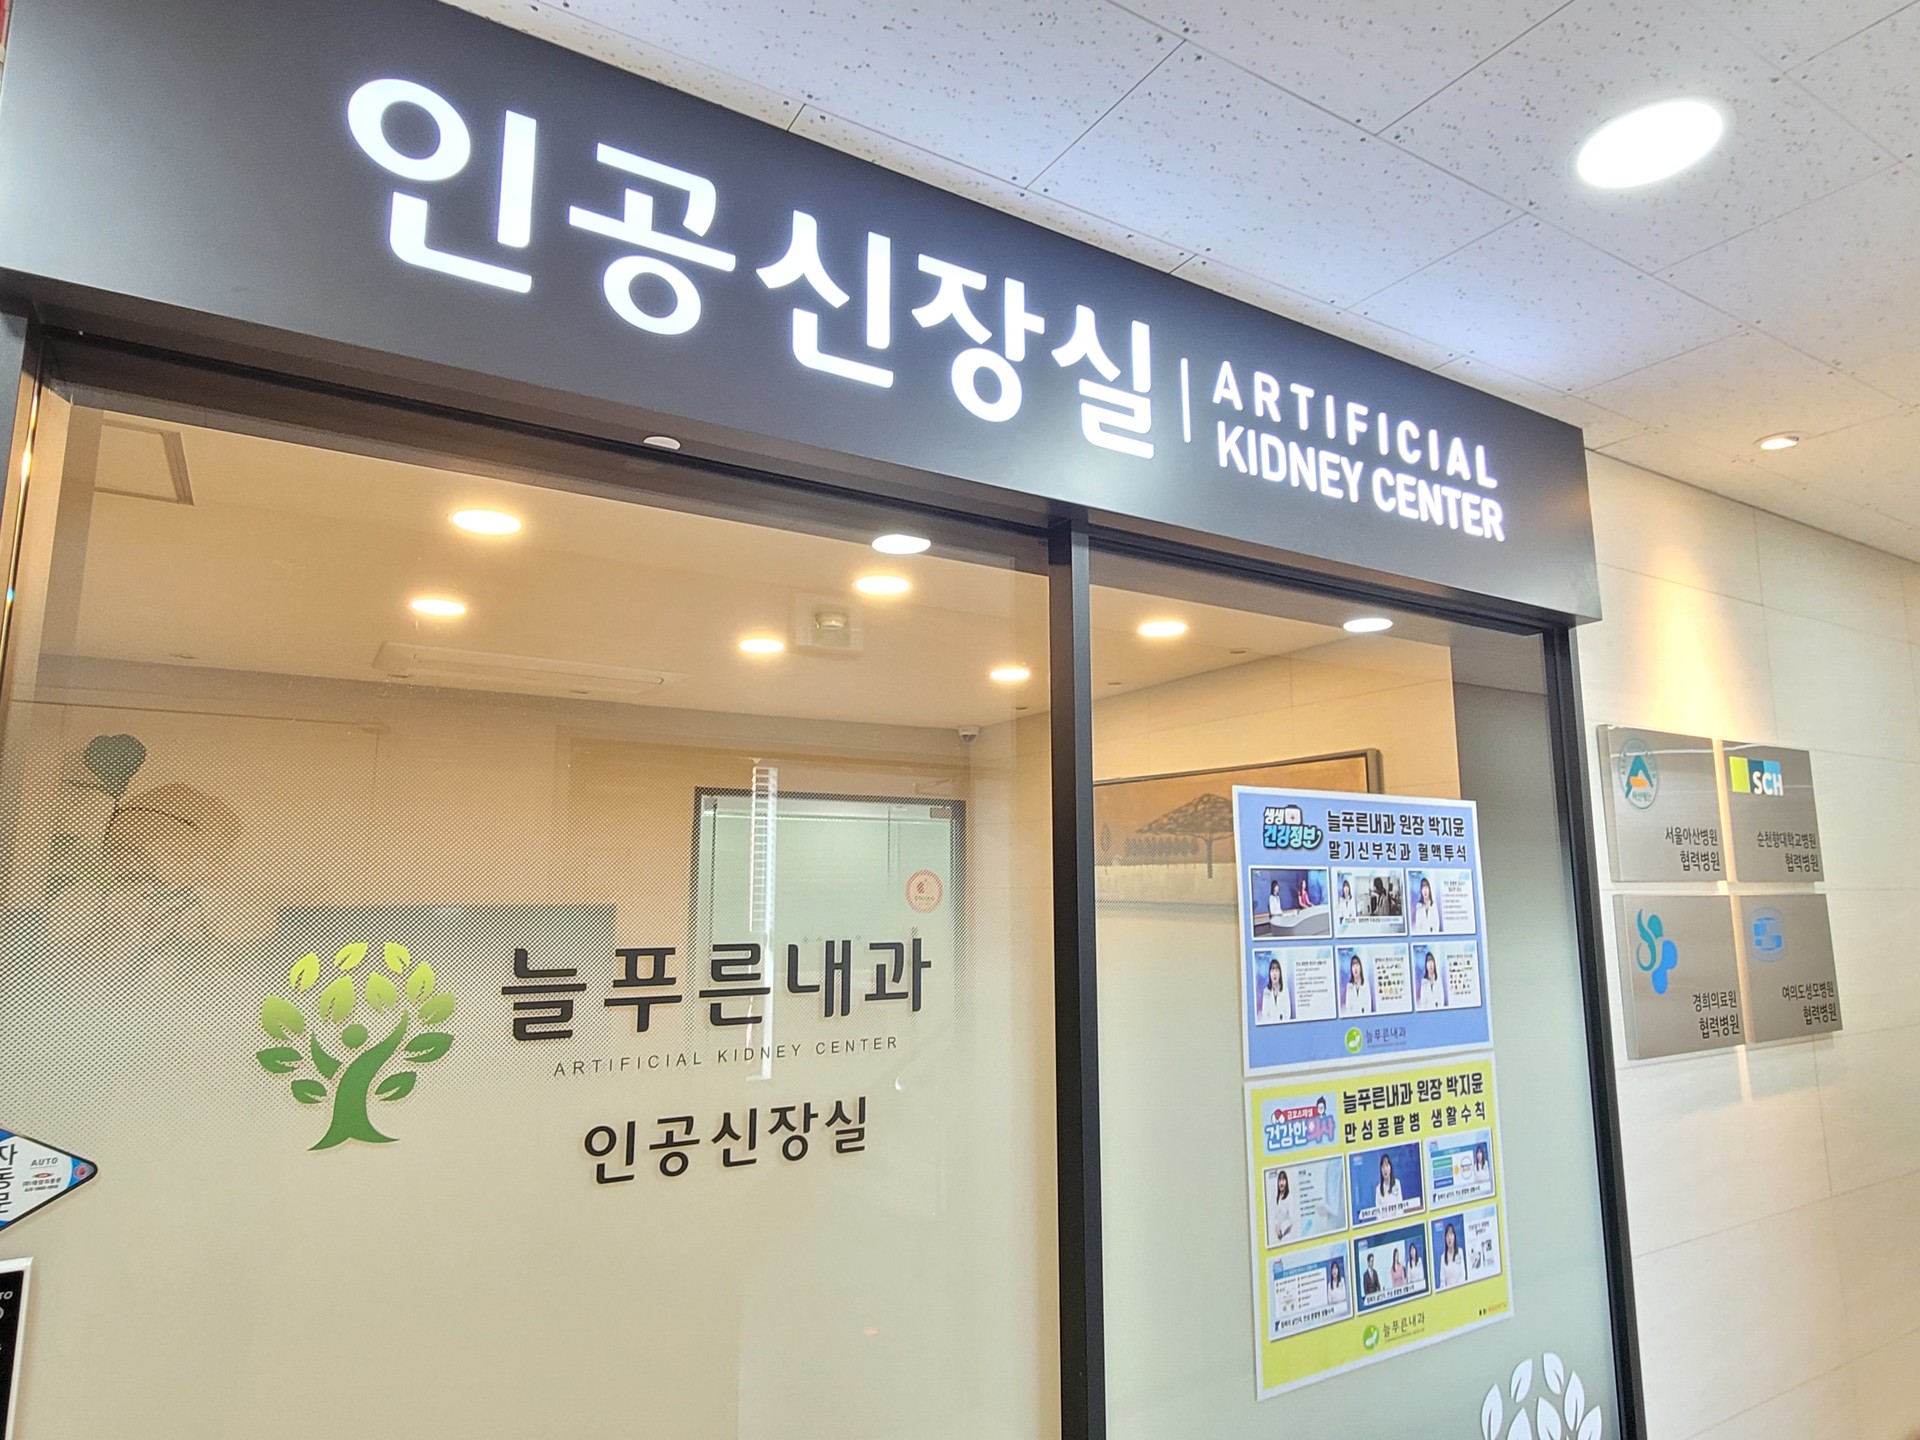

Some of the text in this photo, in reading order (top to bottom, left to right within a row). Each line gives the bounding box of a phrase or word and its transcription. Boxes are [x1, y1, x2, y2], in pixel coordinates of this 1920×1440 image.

[347, 78, 1155, 459] 인공신장실
[1212, 360, 1499, 489] ARTIFICIAL
[1217, 420, 1506, 542] KIDNEY CENTER
[1752, 770, 1784, 797] SCH
[1264, 808, 1285, 825] 생생
[1327, 810, 1465, 837] 늘푸른내과 원장 박지윤
[1264, 825, 1322, 849] 건강정보
[1664, 826, 1719, 846] 서울아산병원
[1756, 831, 1817, 849] 순천향대학교병원
[1328, 840, 1467, 862] 말기신부전과 혈액투석
[1680, 850, 1721, 872] 협력병원
[1785, 853, 1820, 872] 협력병원
[501, 937, 932, 1041] 늘푸른내과
[1692, 990, 1738, 1012] 경희의료원
[1782, 981, 1835, 1001] 여의도성모병원
[1699, 1013, 1740, 1039] 협력병원
[1803, 1002, 1838, 1025] 협력병원
[1365, 1027, 1407, 1044] 늘푸른내과
[553, 1036, 898, 1077] ARTIFICIAL KIDNEY CENTER
[1342, 1072, 1483, 1114] 늘푸른내과 원장 박지윤
[1265, 1115, 1335, 1150] 건강한 의사
[1344, 1101, 1486, 1144] 만성콩팥병 생활수칙
[584, 1096, 868, 1185] 인공신장실
[31, 1157, 58, 1167] AUTO
[1383, 1311, 1425, 1338] 늘푸른내과
